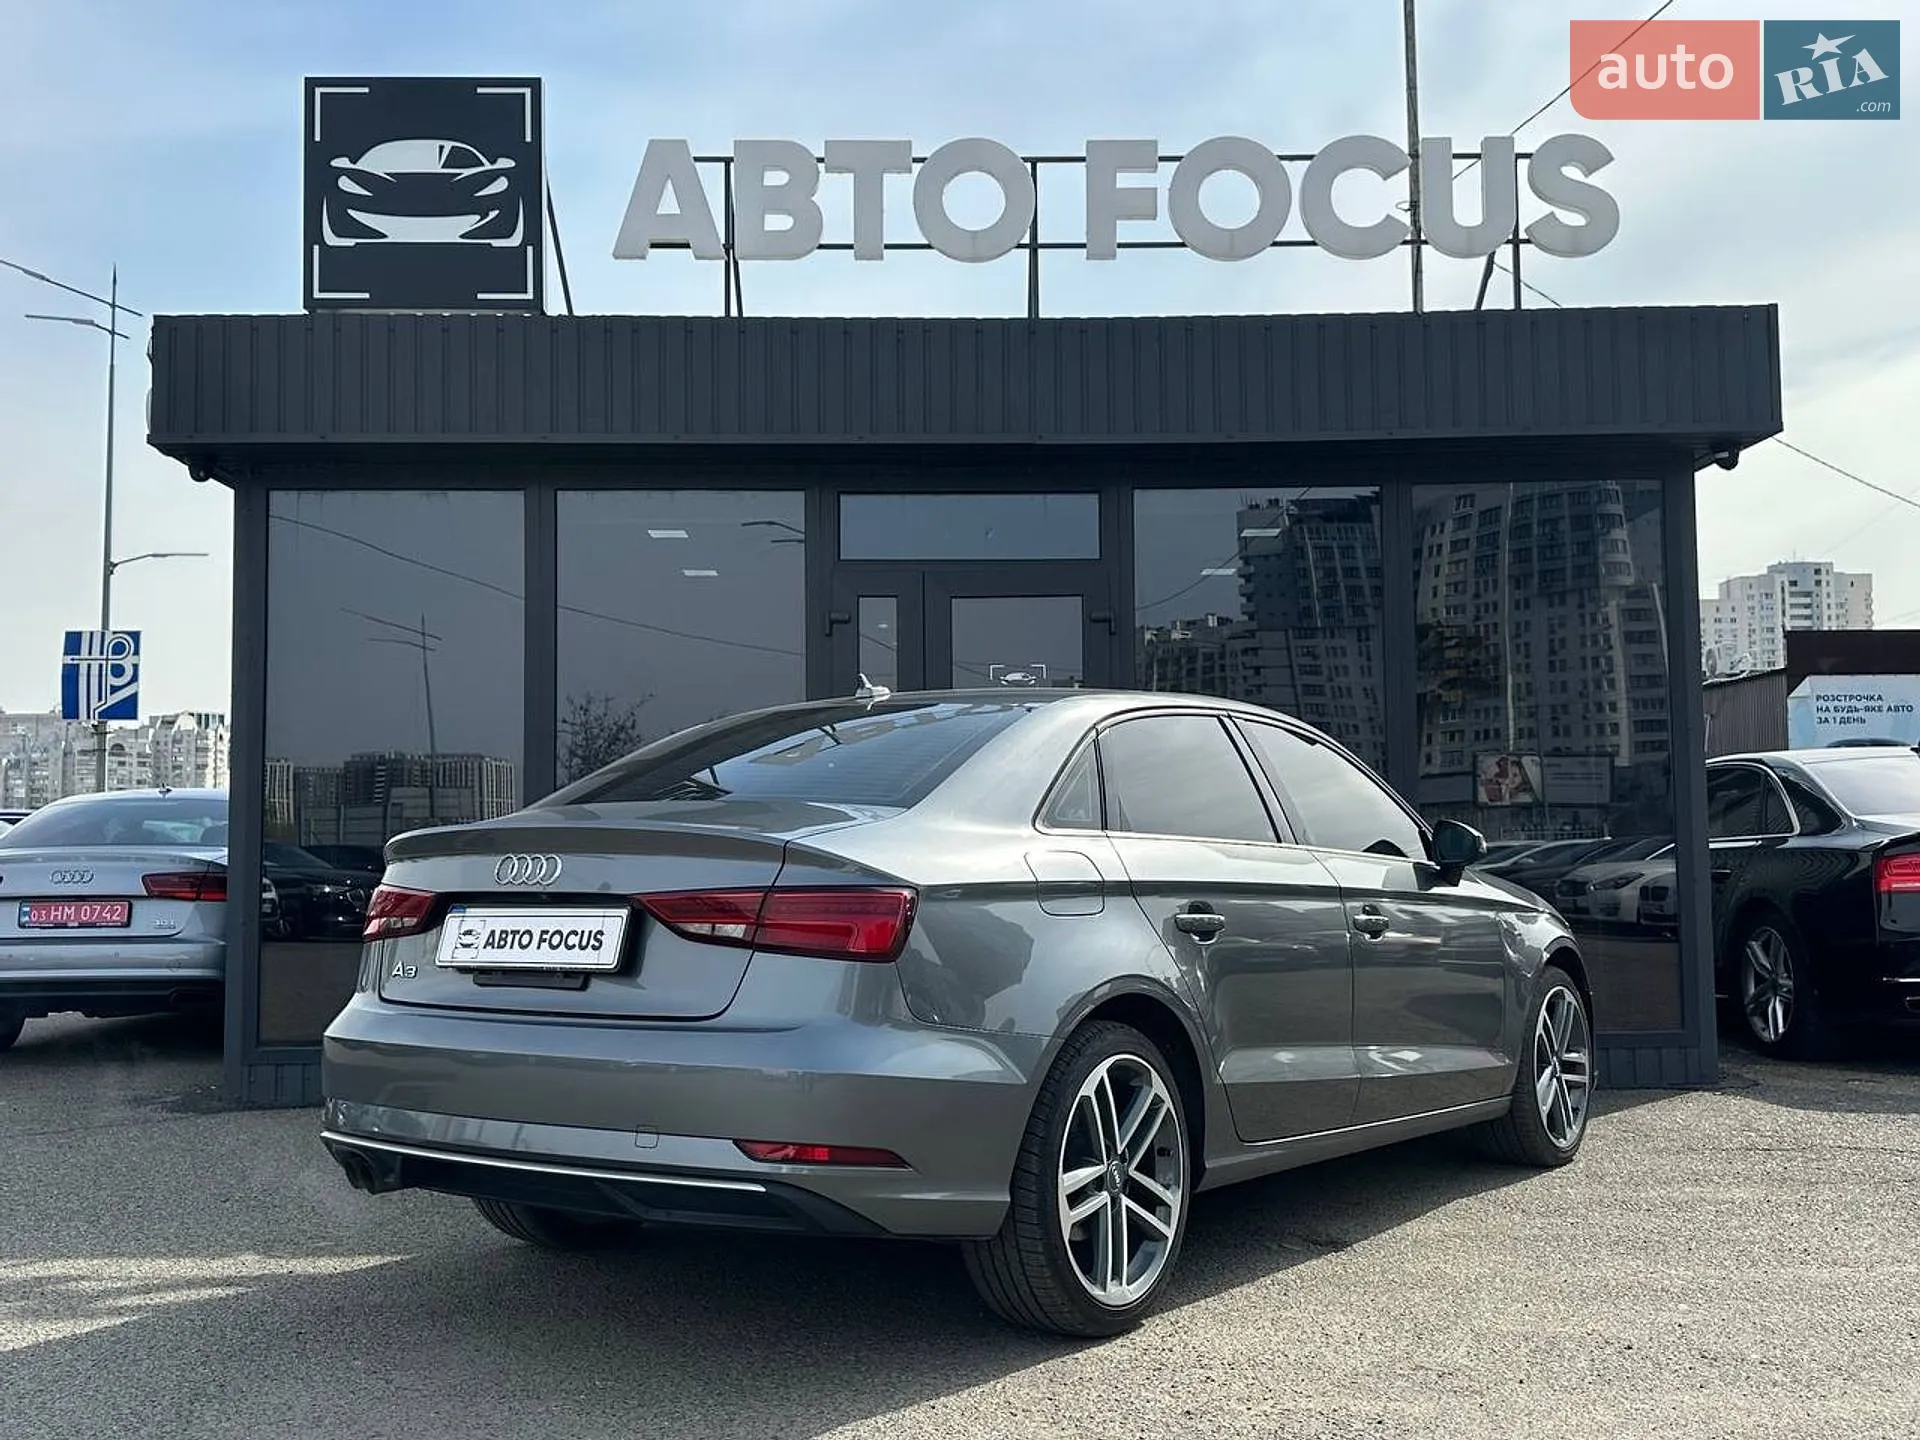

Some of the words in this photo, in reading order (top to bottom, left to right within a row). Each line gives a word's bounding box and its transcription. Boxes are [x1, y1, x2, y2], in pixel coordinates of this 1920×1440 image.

[1086, 133, 1620, 262] FOCUS
[1815, 694, 1883, 702] РОЗСТРОЧКА
[1816, 705, 1831, 714] НА
[1833, 705, 1884, 714] БУДЬ-ЯКЕ
[1816, 716, 1830, 725] ЗА
[1839, 716, 1866, 726] ДЕНЬ
[30, 910, 47, 922] 03
[80, 904, 122, 921] 0742
[536, 929, 605, 951] FOCUS
[391, 960, 418, 978] A3
